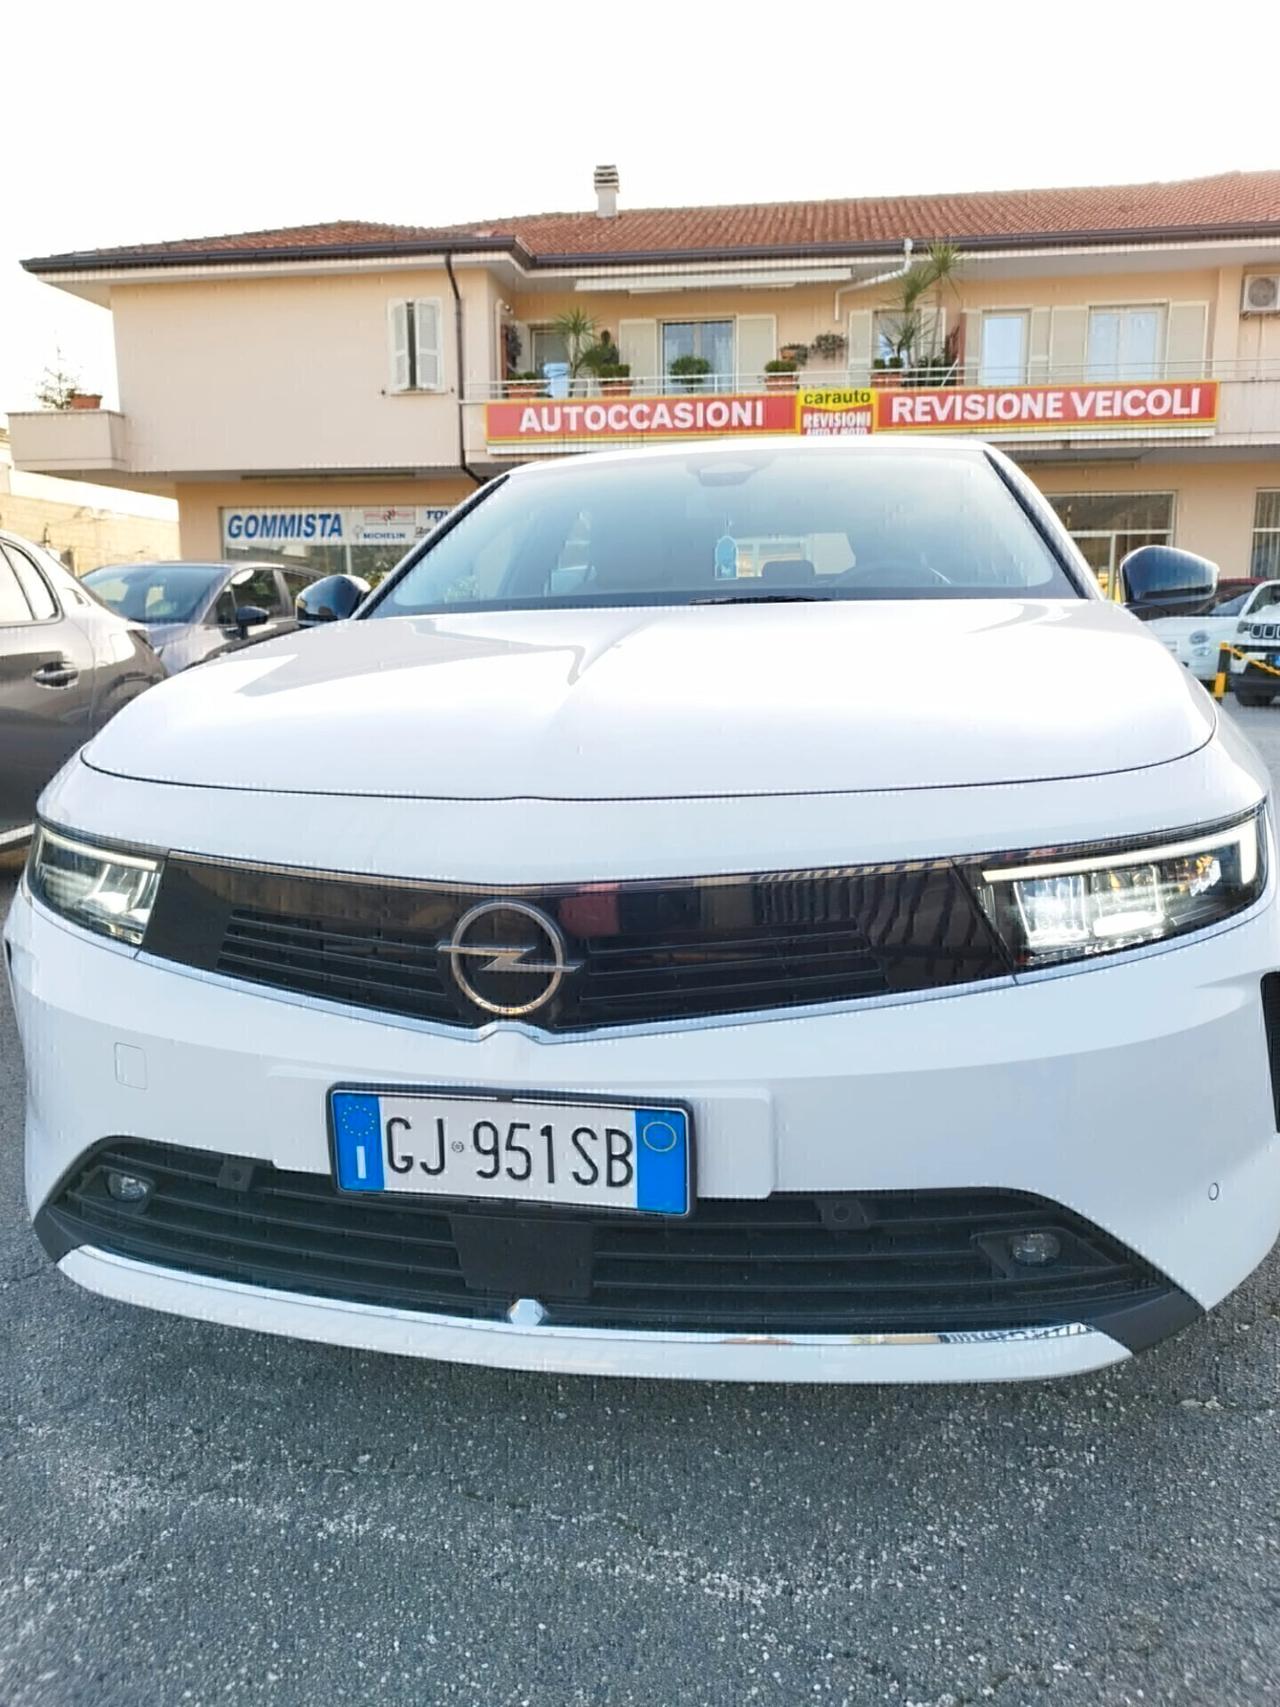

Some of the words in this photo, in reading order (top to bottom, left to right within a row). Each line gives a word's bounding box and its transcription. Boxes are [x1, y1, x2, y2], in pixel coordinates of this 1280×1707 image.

[804, 389, 871, 405] carauto
[891, 392, 1064, 423] REVISIONE
[1069, 387, 1201, 417] VEICOLI
[519, 400, 764, 433] AUTOCCASIONI
[803, 411, 871, 428] REVISIONI
[228, 513, 343, 539] GOMMISTA
[363, 532, 406, 540] MICHELIN
